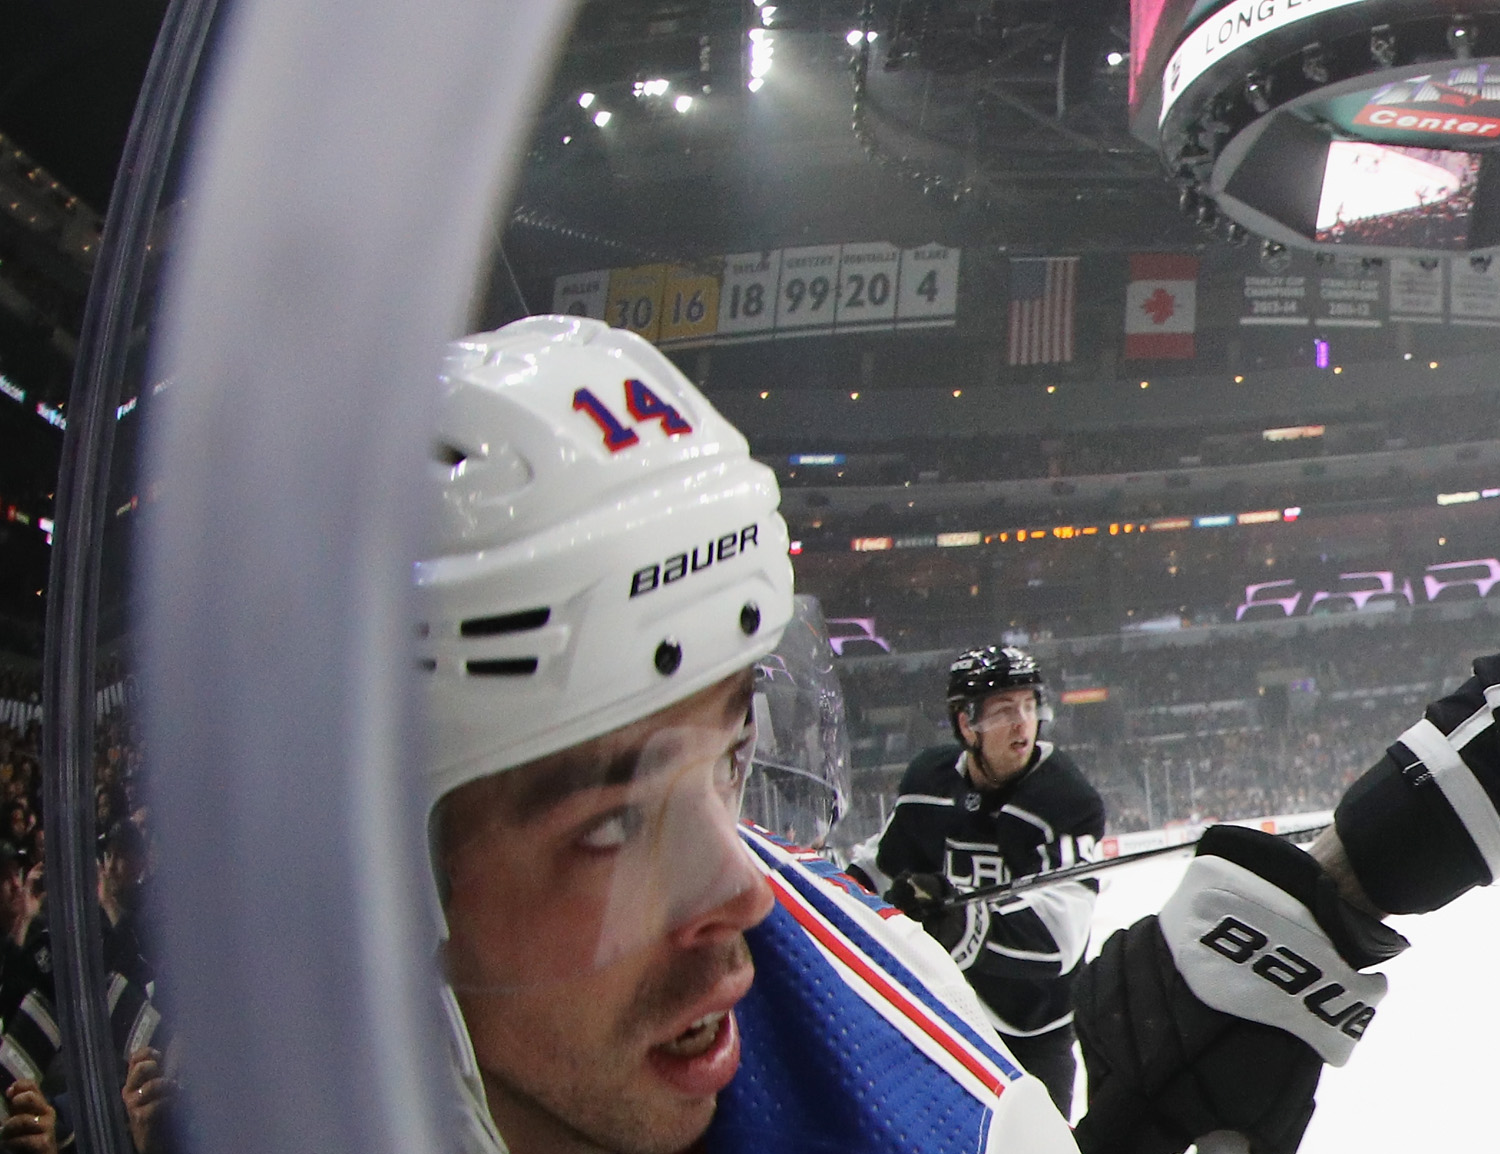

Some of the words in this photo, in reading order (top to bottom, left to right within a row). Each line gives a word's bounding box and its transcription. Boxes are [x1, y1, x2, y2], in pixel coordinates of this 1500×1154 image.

[1206, 0, 1275, 54] LONG
[1368, 109, 1498, 136] Center
[730, 283, 765, 319] 18
[786, 277, 830, 313] 99
[846, 272, 891, 308] 20
[916, 269, 939, 303] 4
[614, 296, 653, 330] 30
[672, 289, 705, 325] 16
[572, 379, 693, 455] 14
[946, 850, 1004, 890] LA
